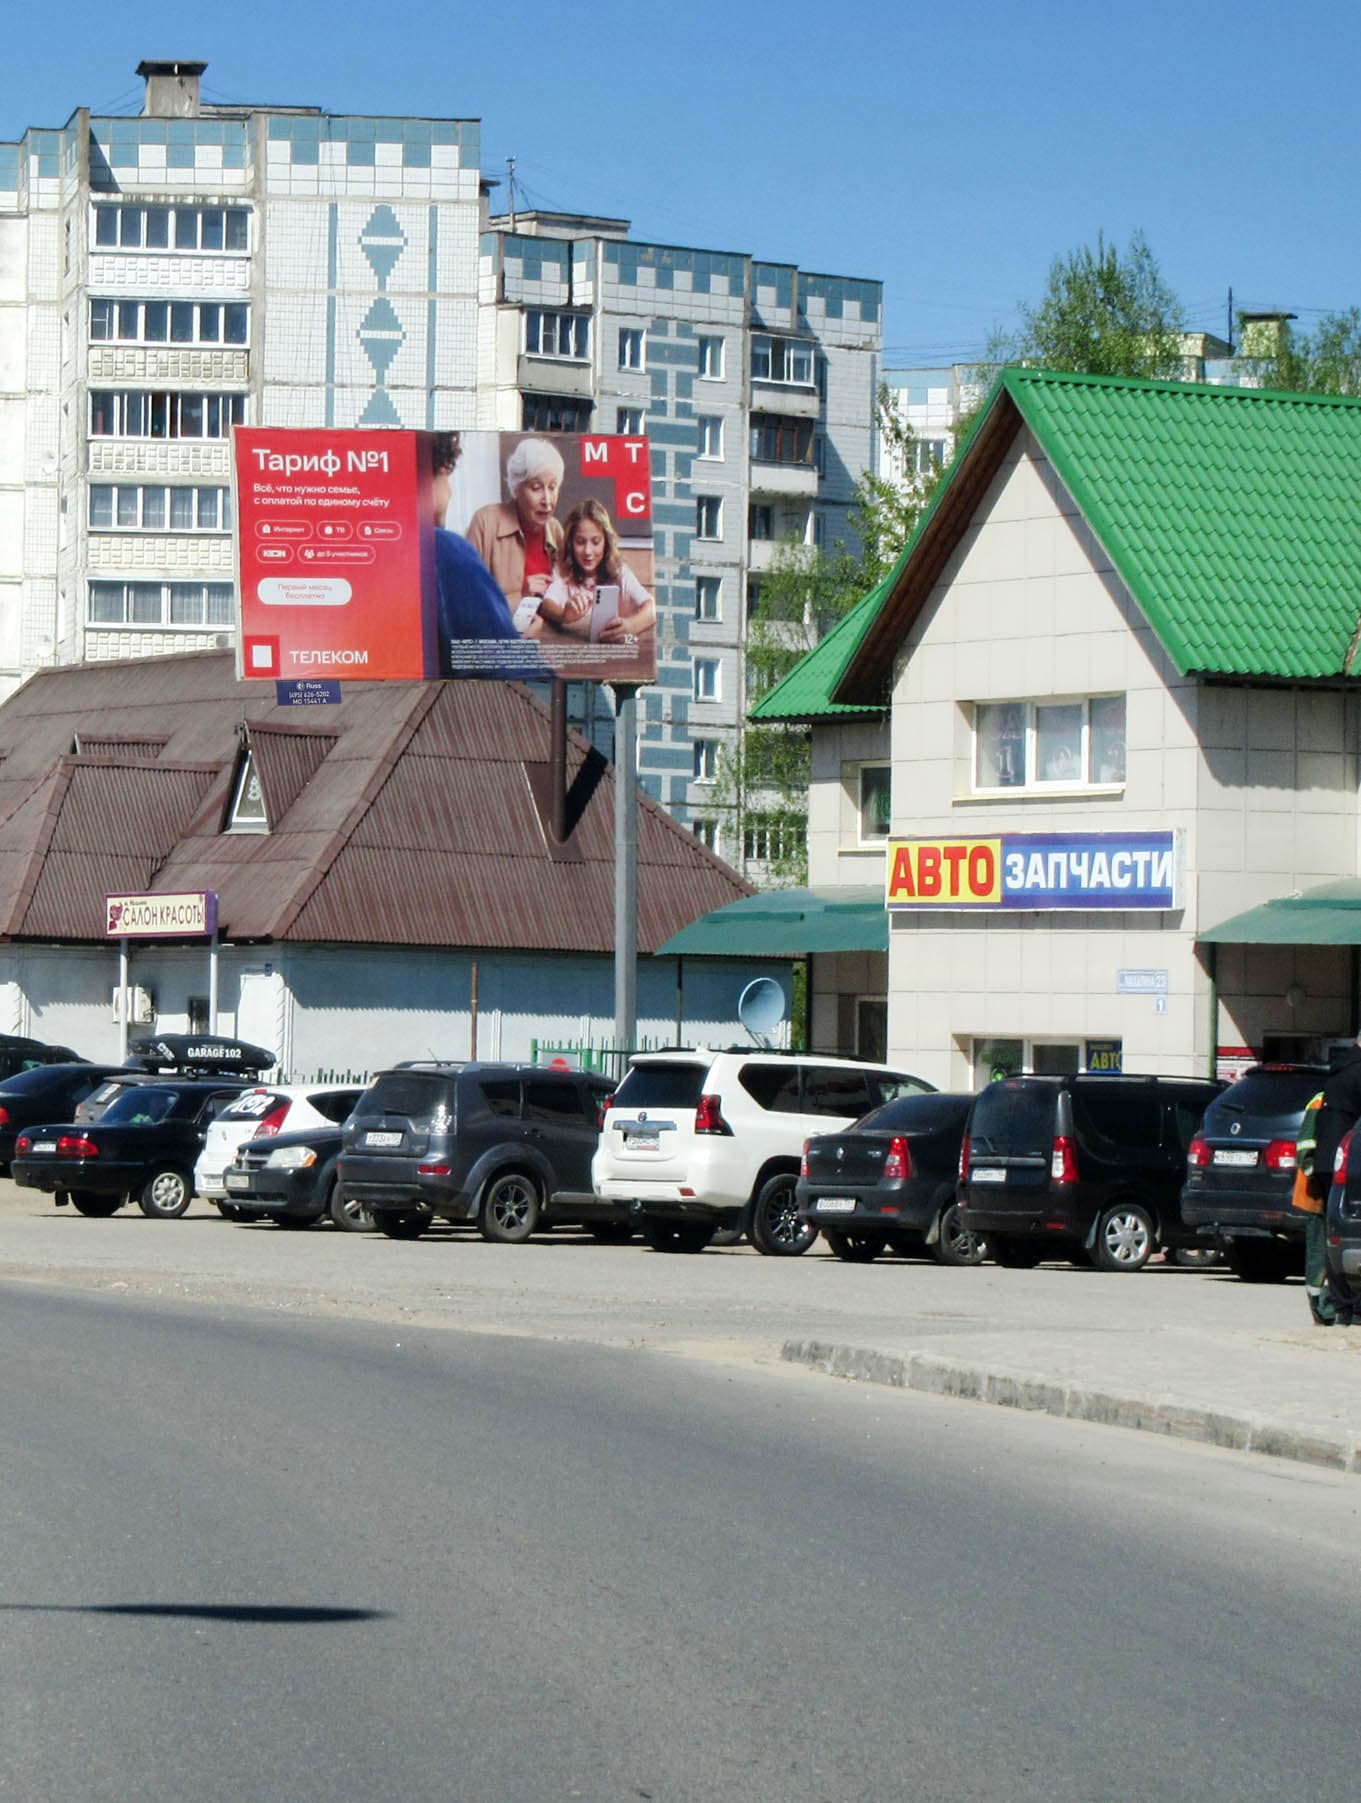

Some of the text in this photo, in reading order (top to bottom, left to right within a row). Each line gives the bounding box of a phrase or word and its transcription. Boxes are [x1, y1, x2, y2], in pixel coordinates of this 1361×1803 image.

[252, 448, 389, 477] Тариф №1
[253, 483, 274, 494] Всё,
[295, 486, 326, 496] нужно
[328, 486, 360, 495] семье,
[262, 496, 302, 505] оплатой
[304, 498, 315, 506] по
[317, 498, 360, 508] единому
[362, 497, 389, 508] счёту
[624, 634, 639, 644] 12+
[290, 650, 368, 664] ТЕЛЕКОМ
[889, 845, 1172, 897] АВТО ЗАПЧАСТИ
[123, 904, 205, 926] САЛОН КРАСОТЫ
